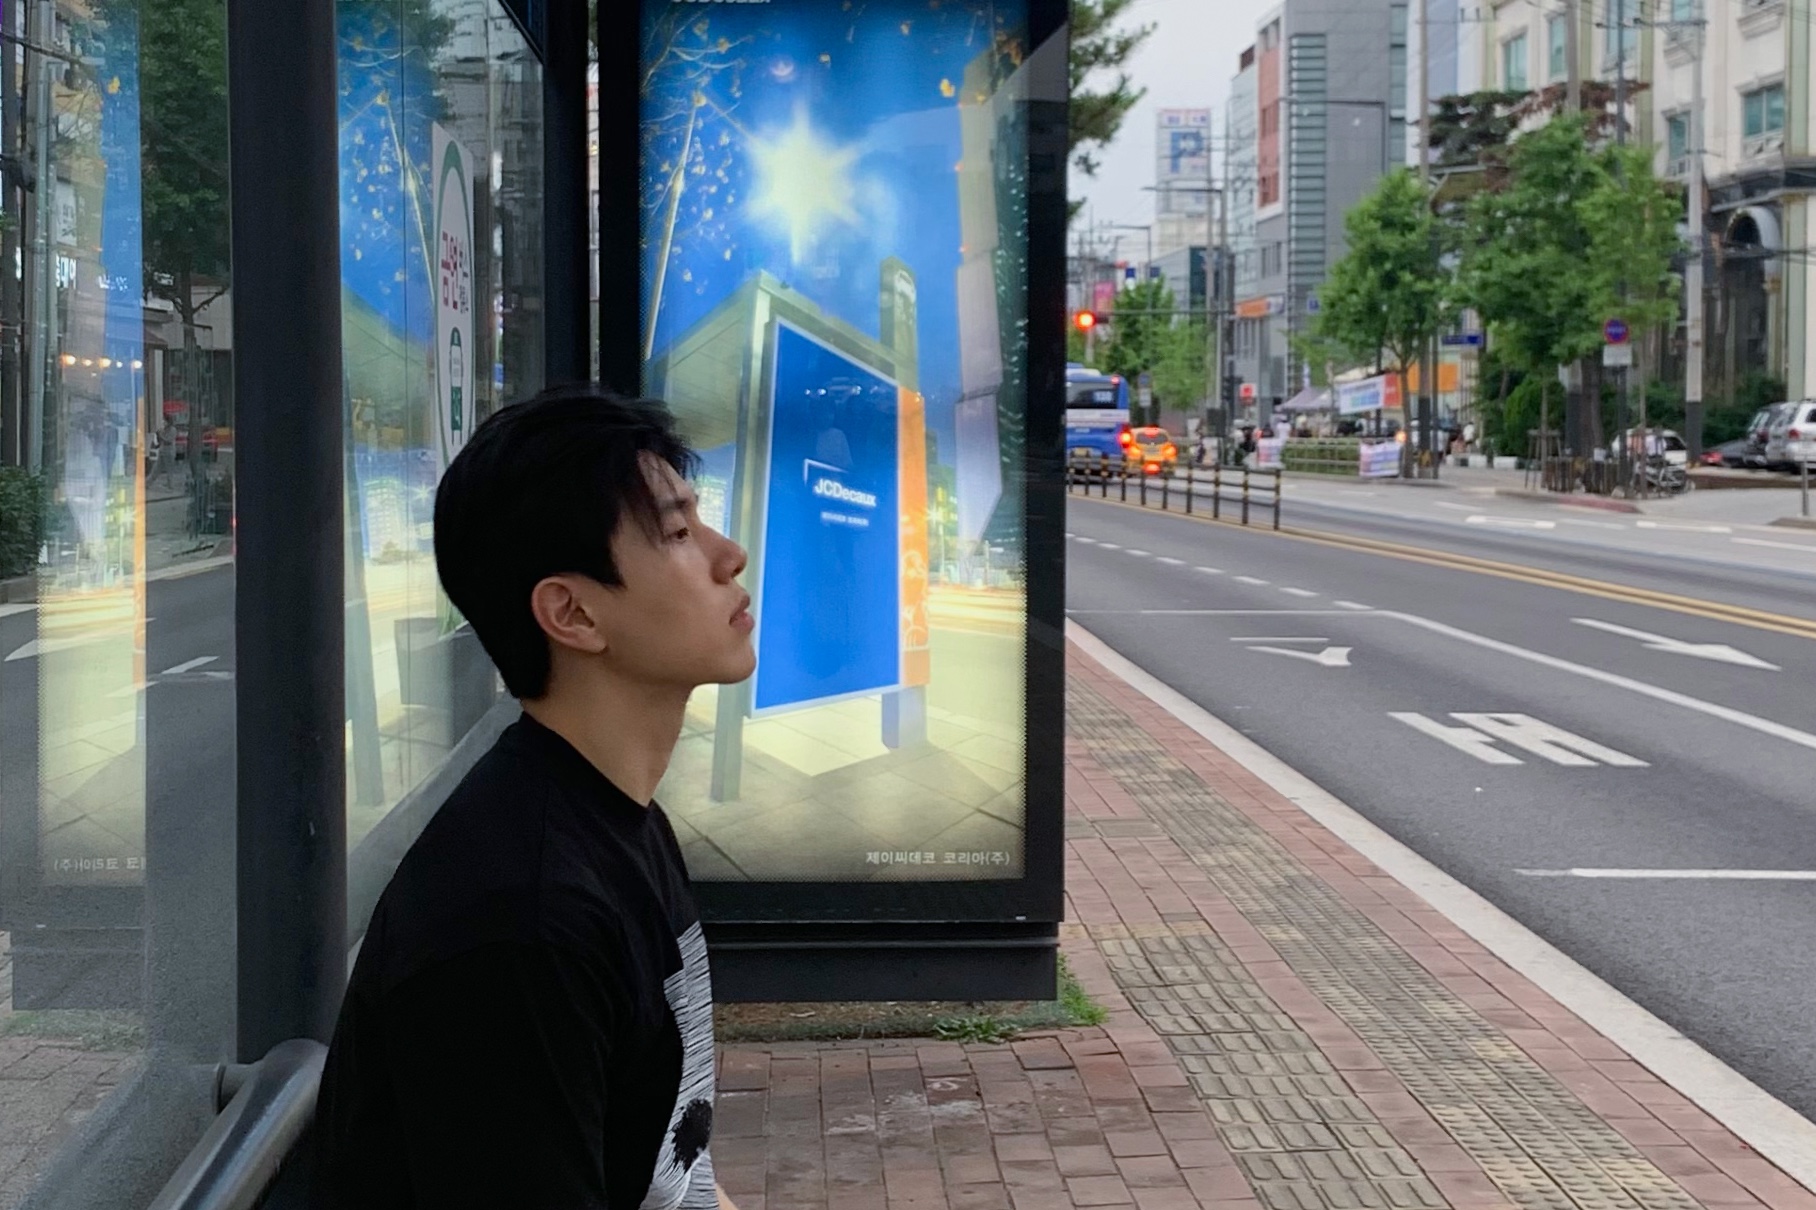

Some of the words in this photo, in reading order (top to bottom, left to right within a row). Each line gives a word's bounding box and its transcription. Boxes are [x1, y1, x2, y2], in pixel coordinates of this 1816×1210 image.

[441, 230, 459, 311] 금연
[813, 477, 877, 507] JCDecaux
[865, 851, 936, 865] 제이씨데코
[943, 851, 1010, 865] 코리아(주)
